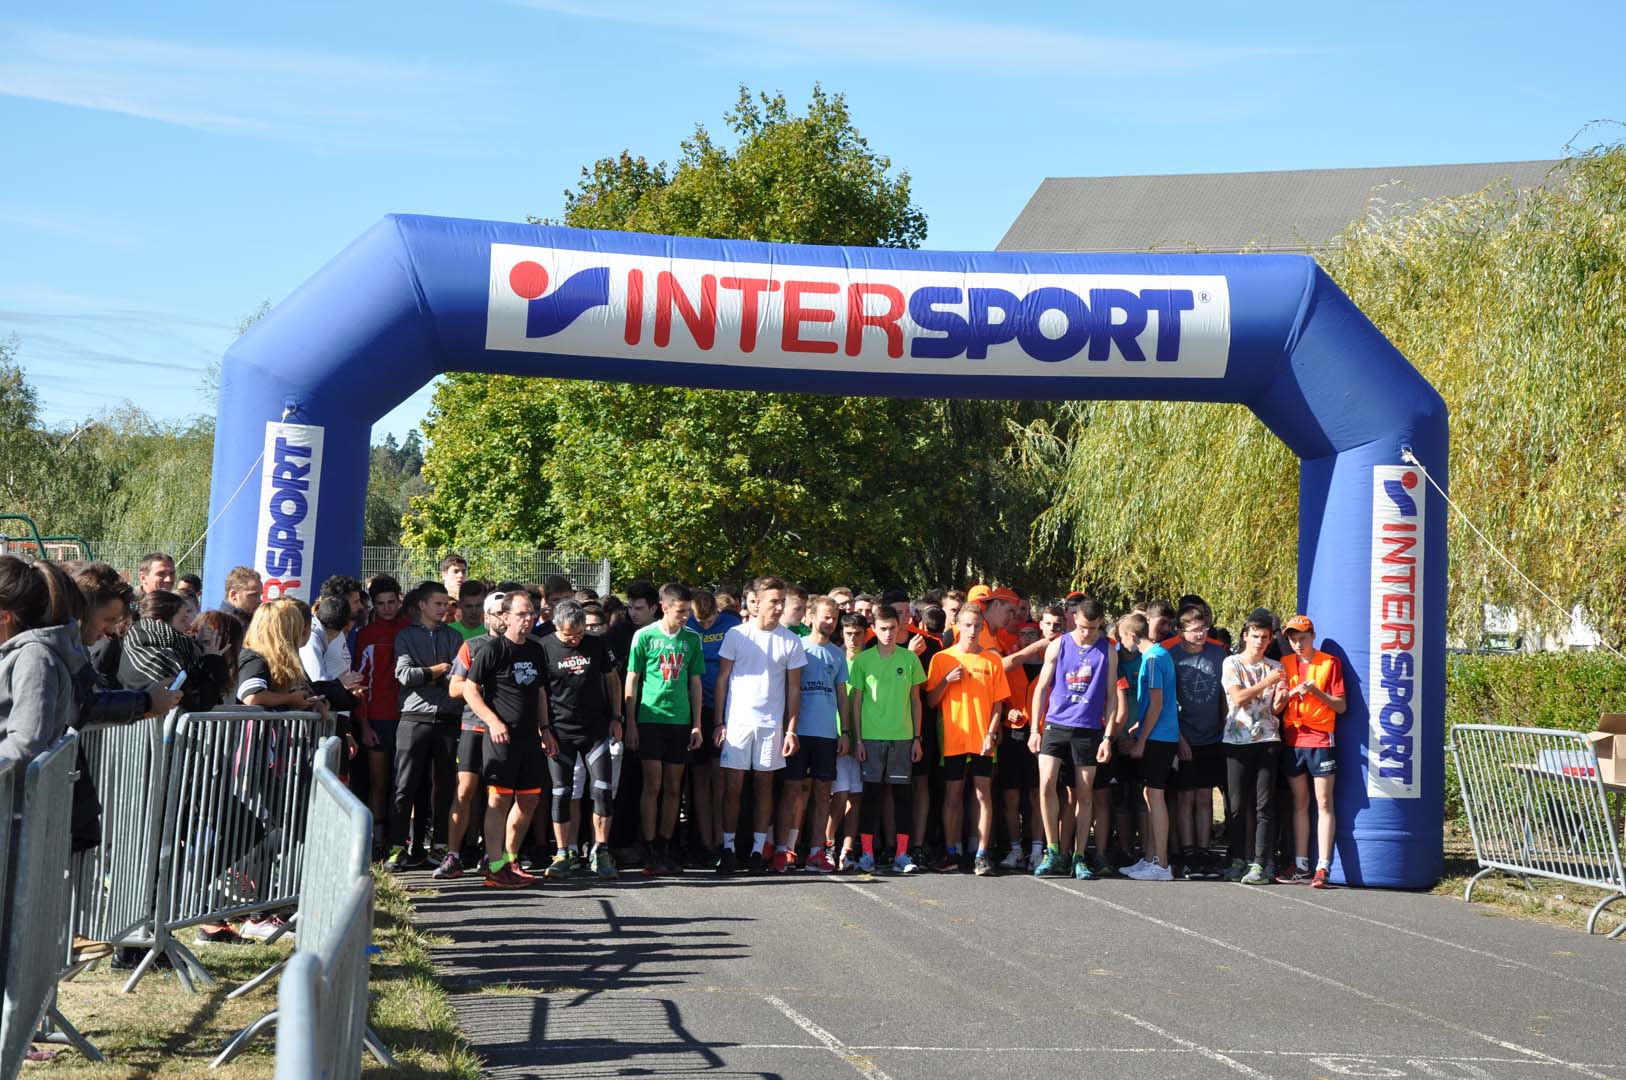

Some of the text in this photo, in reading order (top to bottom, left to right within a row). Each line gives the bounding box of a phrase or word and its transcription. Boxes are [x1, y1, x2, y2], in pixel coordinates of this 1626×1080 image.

[624, 268, 1194, 363] INTERSPORT
[558, 659, 576, 669] MUD
[1380, 523, 1417, 785] INTERSPORT
